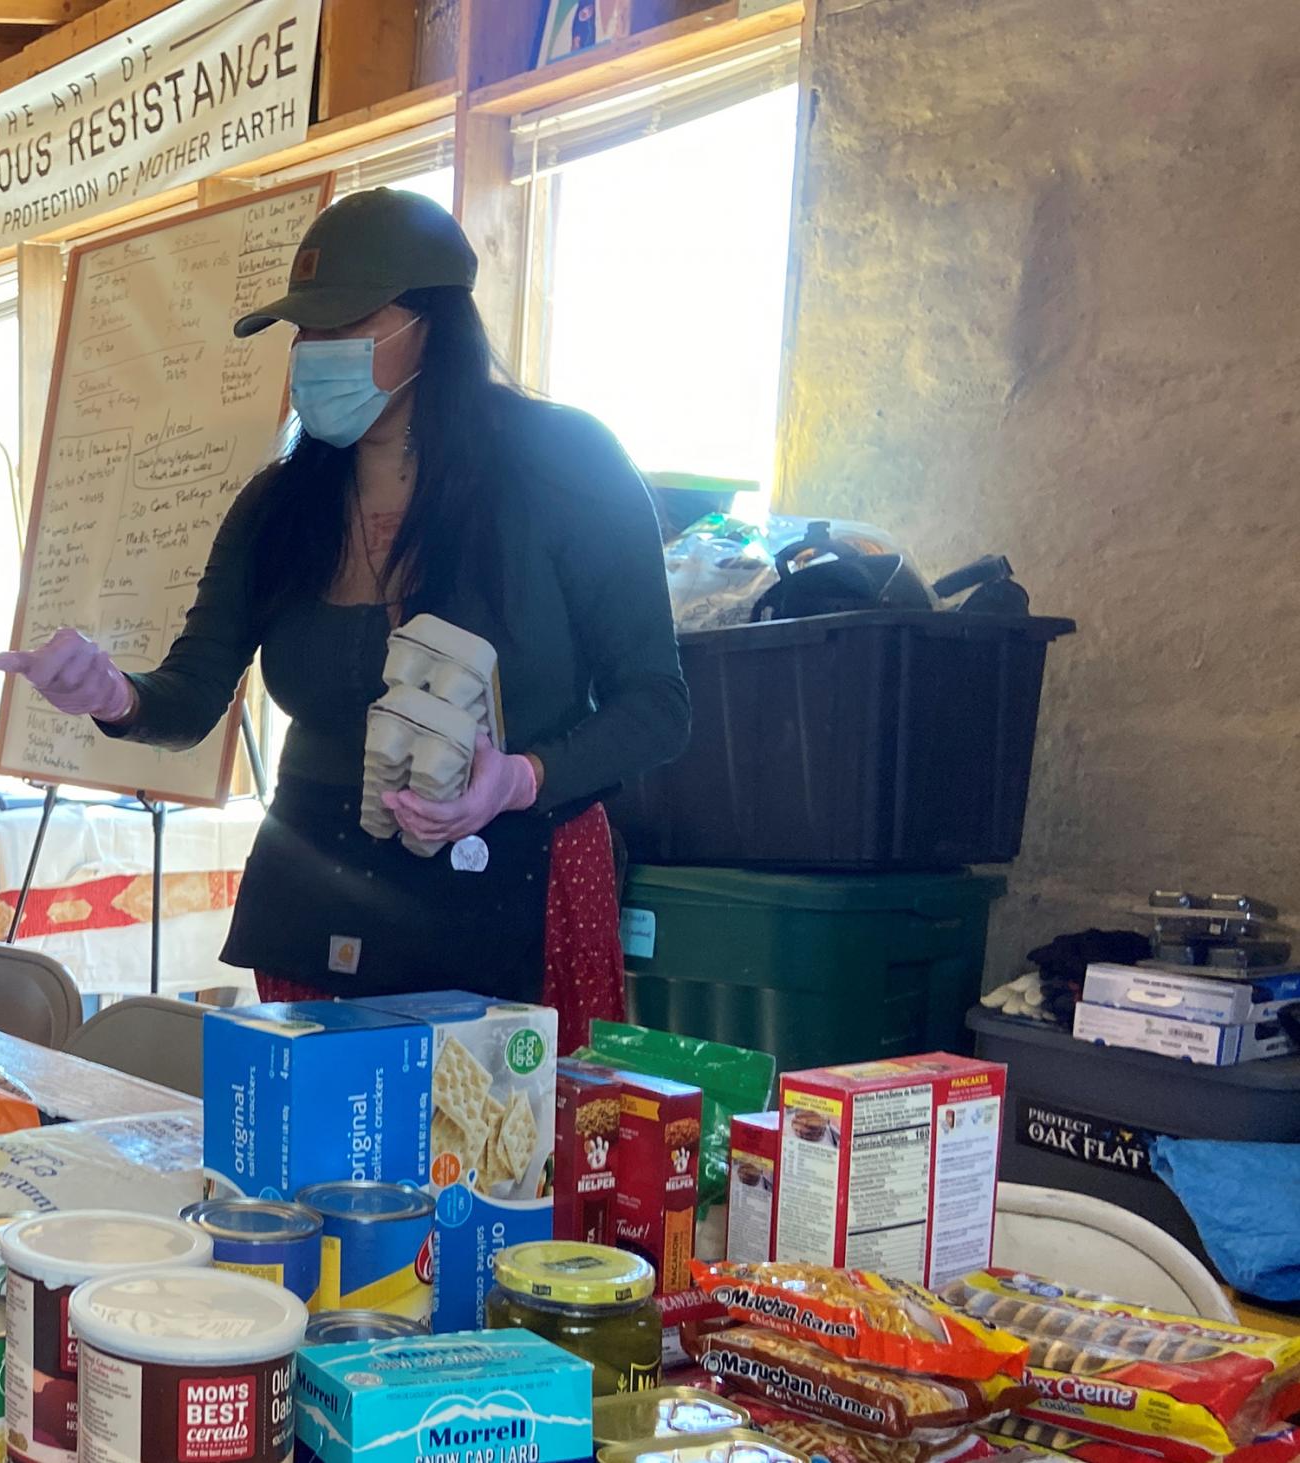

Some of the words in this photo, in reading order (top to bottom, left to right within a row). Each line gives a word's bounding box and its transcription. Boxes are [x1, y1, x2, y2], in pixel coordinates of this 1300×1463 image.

[51, 74, 98, 110] ART
[121, 44, 153, 81] OF
[69, 16, 298, 166] RESISTANCE
[2, 178, 99, 233] PROTECTION
[108, 166, 130, 196] OF
[137, 131, 211, 184] MOTHER
[221, 99, 296, 153] EARTH
[416, 1060, 428, 1068] 4
[516, 1038, 526, 1067] club
[526, 1036, 538, 1067] food
[248, 1065, 257, 1127] crackers
[951, 1075, 989, 1088] PANCAKES
[373, 1067, 384, 1129] crackers
[231, 1083, 247, 1174] original
[1028, 1108, 1091, 1135] PROTECT
[347, 1092, 372, 1182] original
[1027, 1122, 1076, 1154] OAK
[1082, 1135, 1145, 1169] FLAT
[247, 1131, 256, 1178] saltine
[372, 1132, 383, 1181] saltine
[577, 1177, 616, 1193] HELPER
[665, 1177, 694, 1192] HELPER
[616, 1219, 650, 1239] Twist!
[477, 1225, 487, 1273] saltine
[732, 1289, 798, 1323] Maruchan
[800, 1312, 857, 1339] Ramen
[749, 1313, 790, 1333] Chicken
[381, 1345, 482, 1361] Morrell
[187, 1383, 249, 1403] MOM'S
[272, 1364, 290, 1395] Old
[299, 1372, 338, 1414] Morrell
[720, 1351, 814, 1400] Maruchan
[817, 1385, 886, 1424] Ramen
[766, 1384, 793, 1402] Pork
[1056, 1377, 1134, 1406] Creme
[187, 1401, 249, 1424] BEST
[272, 1395, 292, 1424] Oats
[1038, 1400, 1085, 1416] cookies
[187, 1422, 248, 1443] cereals
[429, 1419, 526, 1448] Morrell
[465, 1449, 494, 1463] CAP
[500, 1442, 539, 1463] LARD
